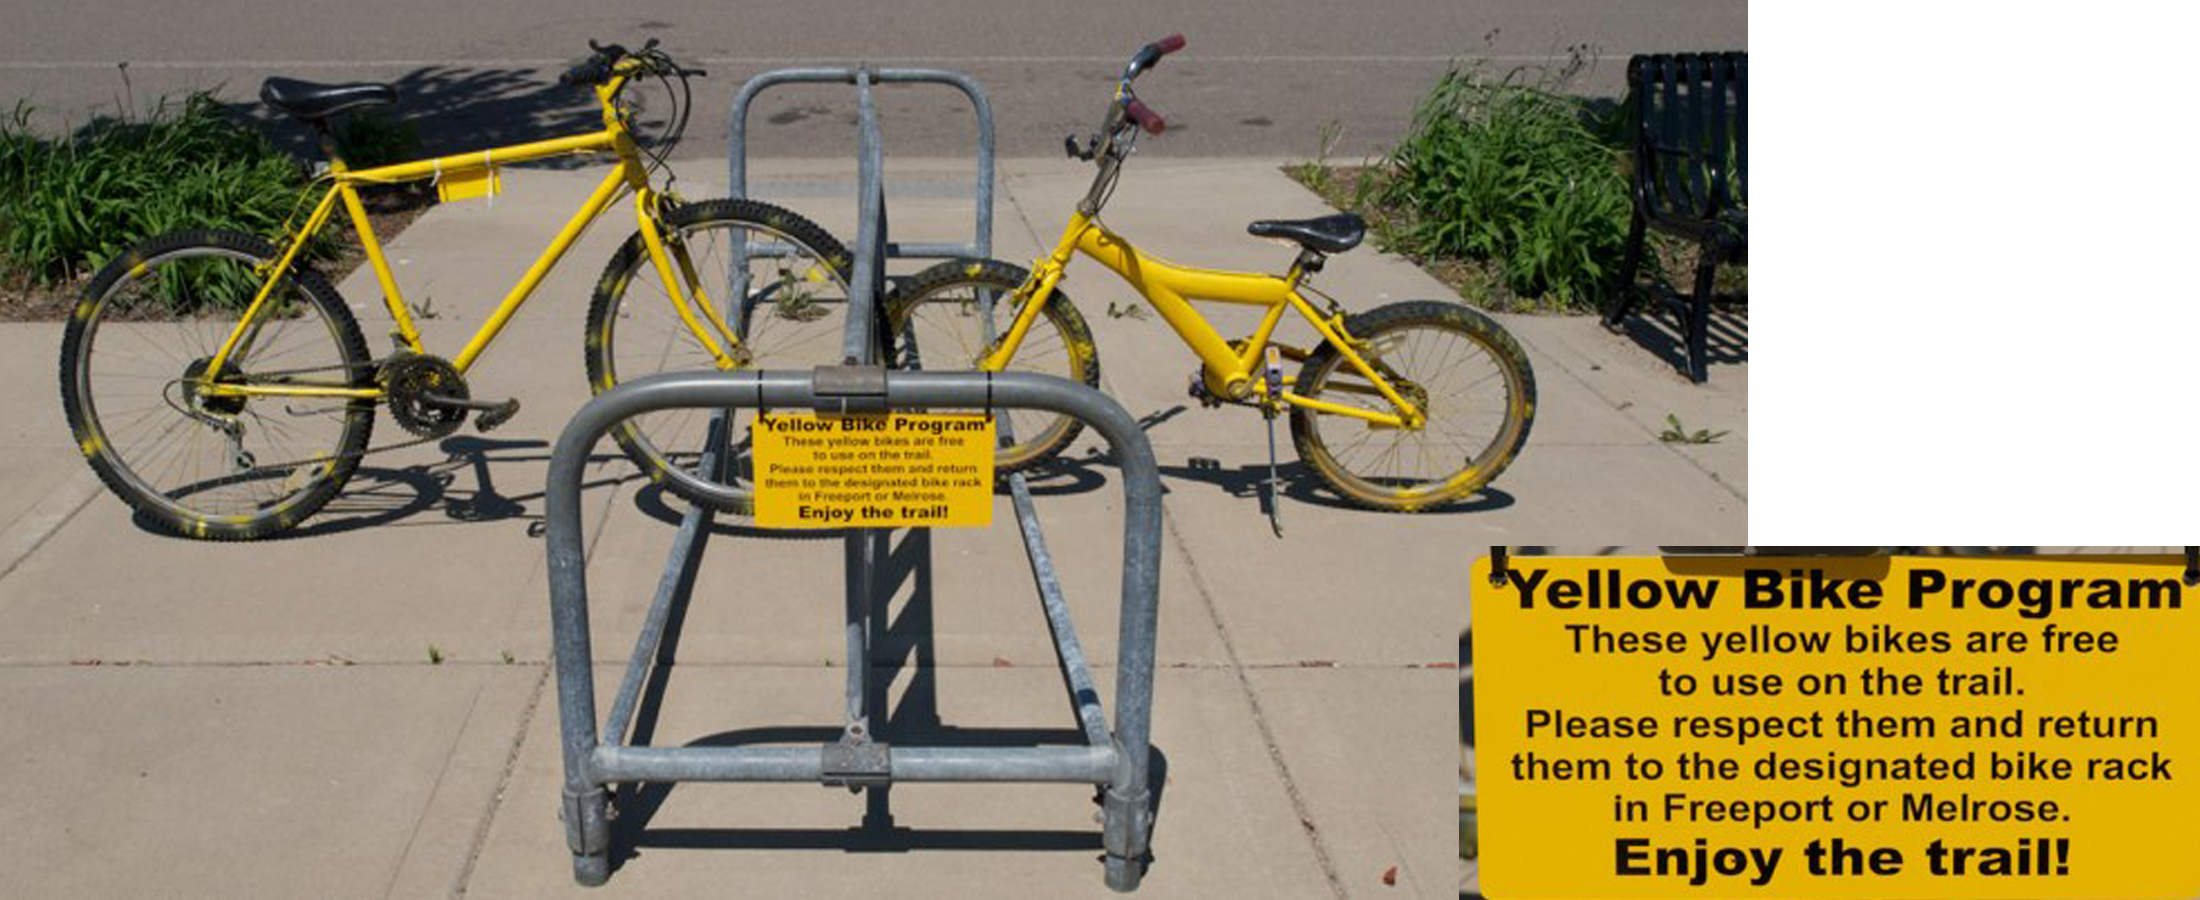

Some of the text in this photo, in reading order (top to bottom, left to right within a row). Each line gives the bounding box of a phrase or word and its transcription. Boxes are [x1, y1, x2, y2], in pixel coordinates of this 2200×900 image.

[765, 418, 985, 435] Yellow Bike Program
[784, 436, 964, 448] These yellow bikes are free
[813, 451, 827, 461] to
[830, 452, 854, 461] use
[857, 451, 876, 460] on
[879, 450, 901, 460] the
[769, 463, 978, 476] Please respect them and return
[765, 477, 981, 489] them to the designated bike rack
[798, 493, 811, 501] in
[814, 491, 871, 503] Freeport
[874, 493, 888, 501] or
[798, 505, 949, 523] Enjoy the trail!
[1506, 567, 2184, 620] Yellow Bike Program
[1564, 623, 2118, 661] These yellow bikes are free
[1658, 666, 2024, 696] to use on the trail.
[1527, 709, 2158, 746] Please respect them and return
[1511, 751, 2171, 788] them to the designated bike rack
[1615, 793, 2070, 829] in Freeport or Melrose.
[1615, 837, 2070, 887] Enjoy the trail!
